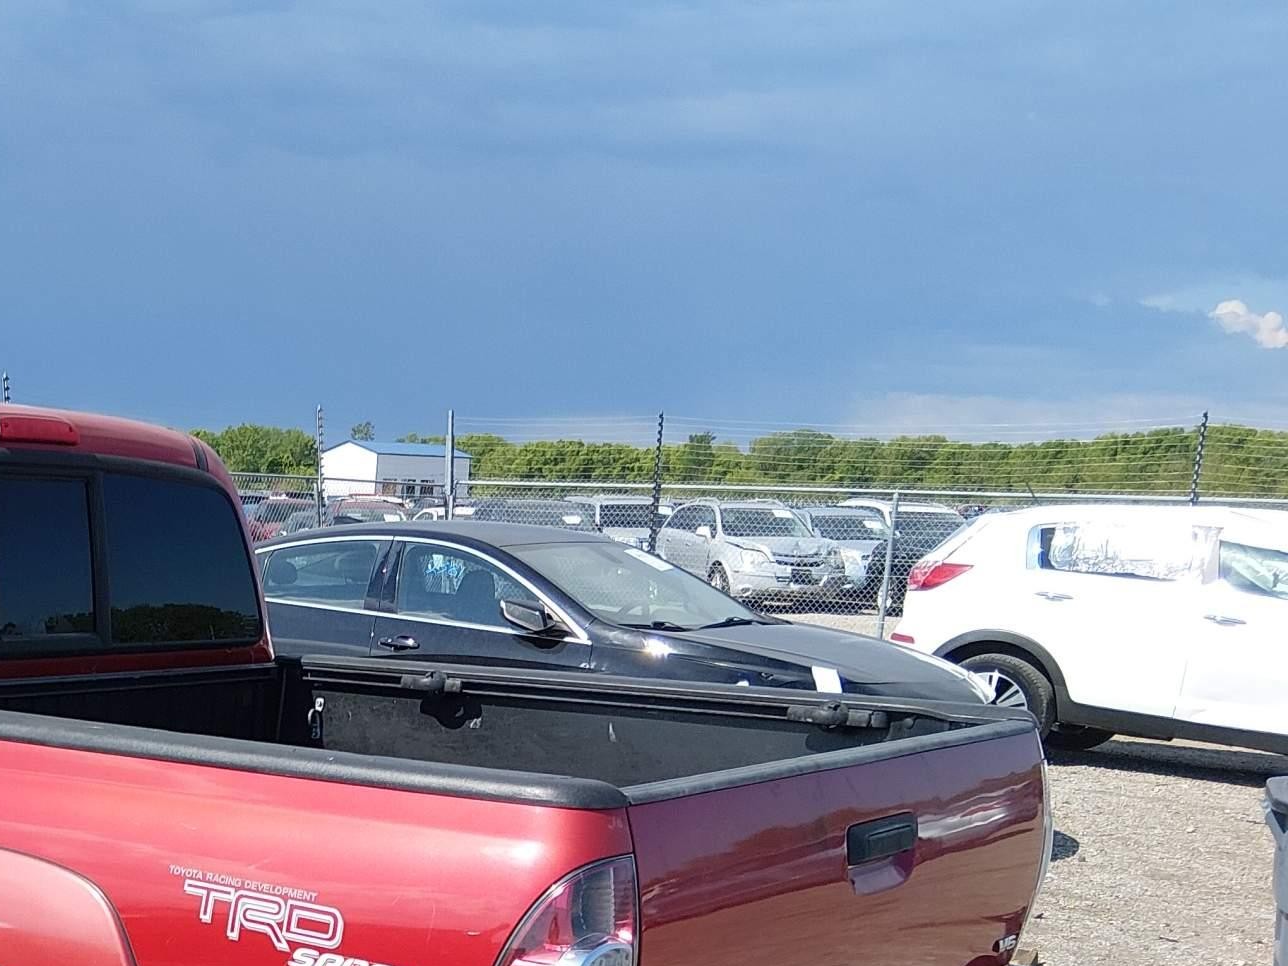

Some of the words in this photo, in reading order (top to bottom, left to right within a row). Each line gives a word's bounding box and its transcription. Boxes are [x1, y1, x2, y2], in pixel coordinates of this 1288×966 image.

[169, 864, 203, 881] TOYOTA
[206, 871, 242, 888] RACING
[244, 879, 319, 902] DEVELOPMENT
[183, 878, 345, 952] TRD
